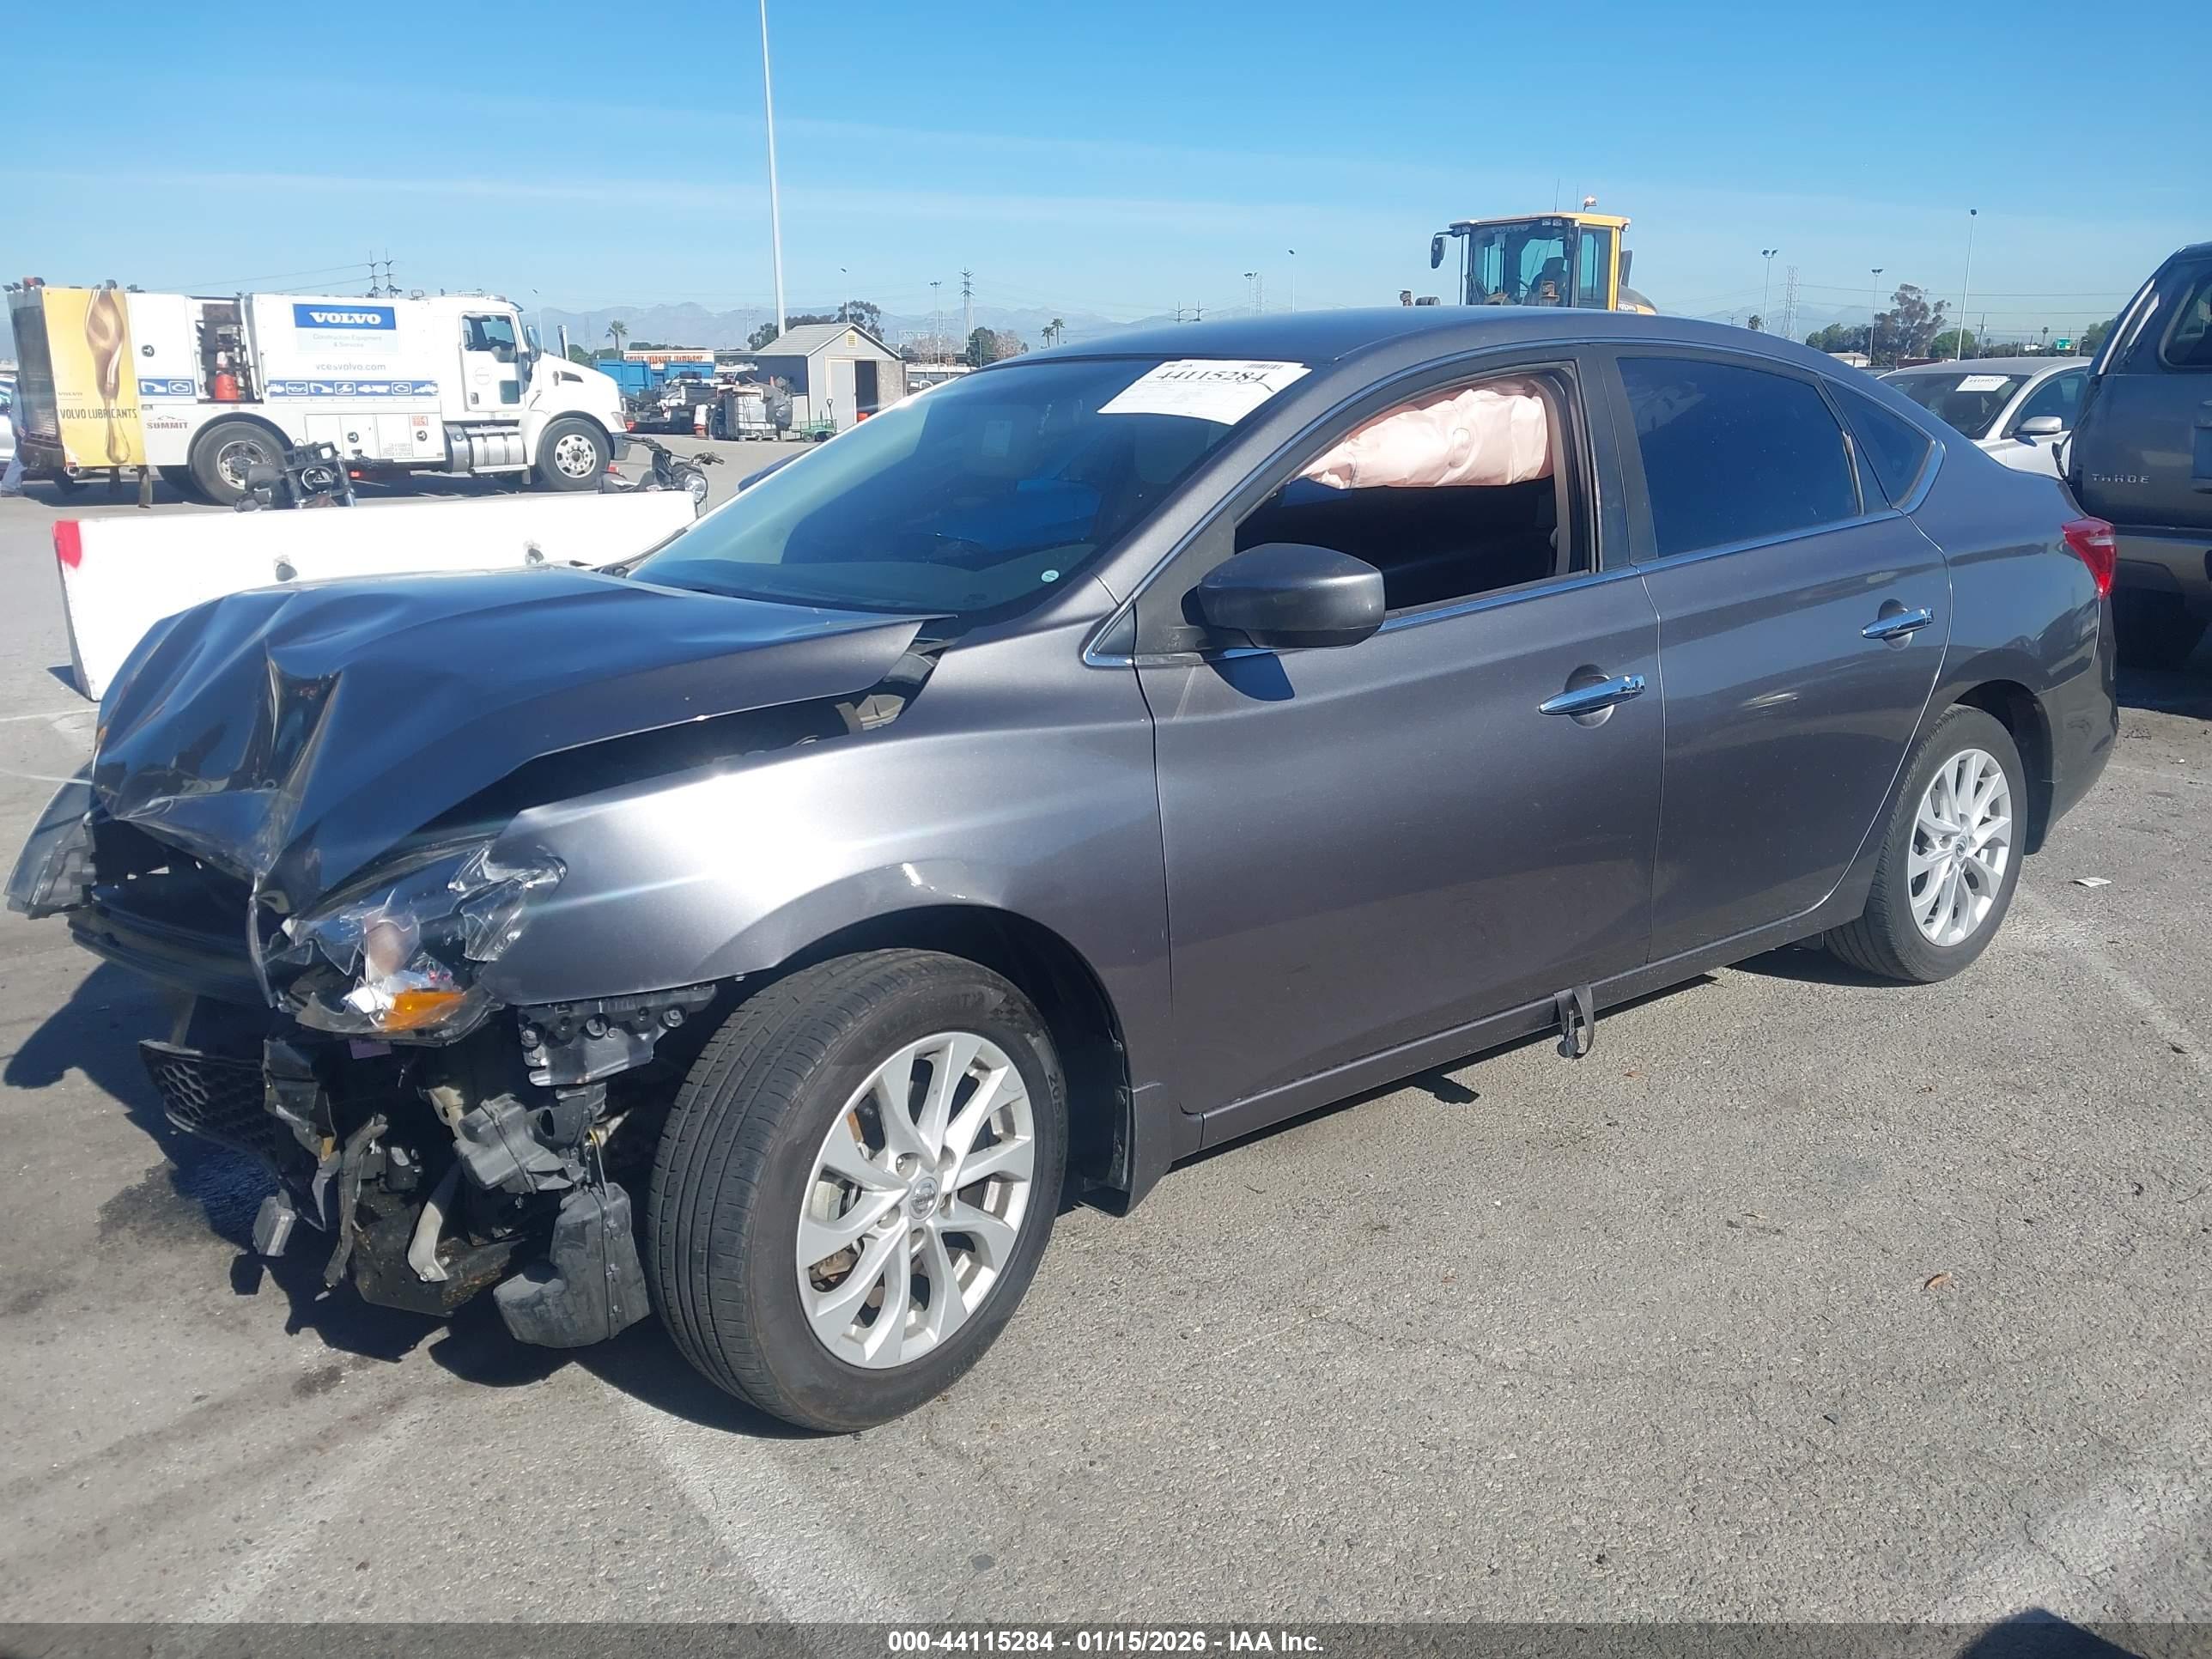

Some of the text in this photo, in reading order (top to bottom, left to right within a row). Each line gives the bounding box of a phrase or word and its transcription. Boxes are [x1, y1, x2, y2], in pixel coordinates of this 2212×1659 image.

[309, 312, 381, 325] VOLVO
[316, 362, 386, 371] vcesvolvo.com
[1156, 370, 1269, 383] 44115284
[60, 408, 137, 419] VOLVO LUBRICANTS
[2091, 473, 2150, 483] TAHOE
